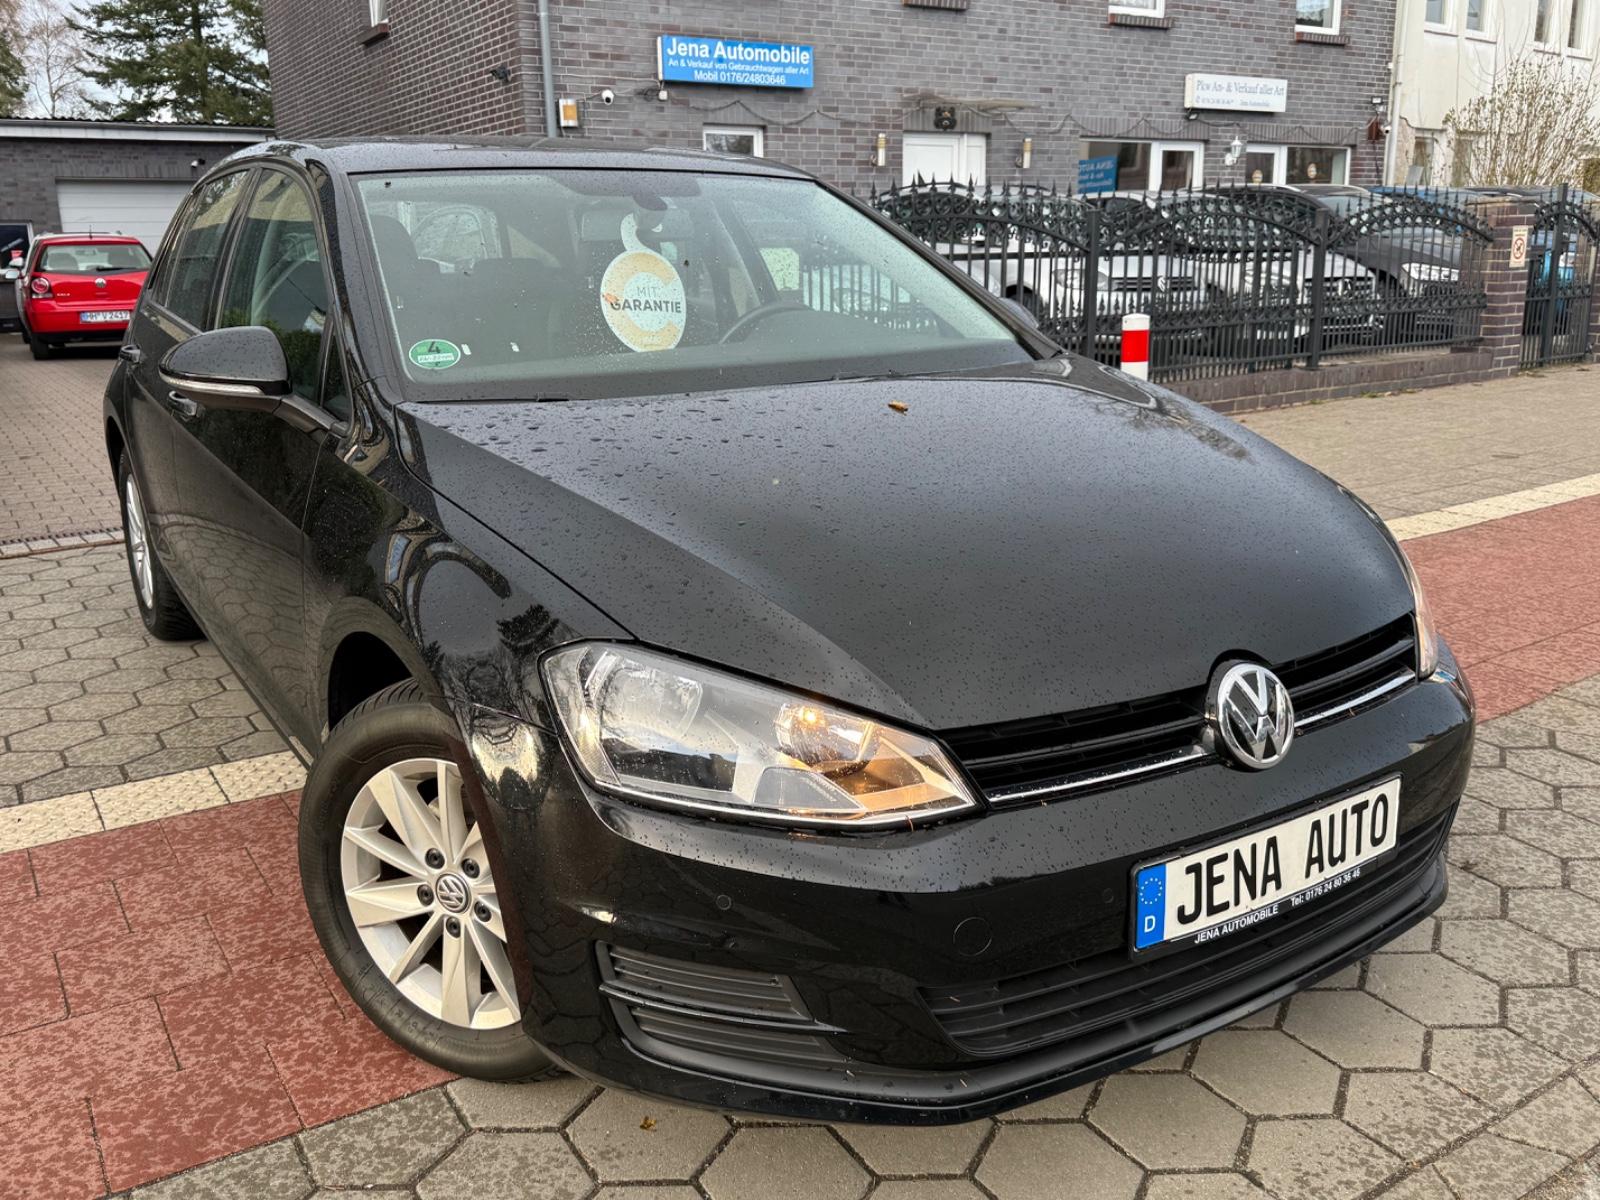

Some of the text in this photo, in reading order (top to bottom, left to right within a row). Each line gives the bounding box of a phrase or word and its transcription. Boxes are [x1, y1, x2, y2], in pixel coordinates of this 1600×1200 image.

[667, 37, 810, 64] Jena Automobile
[668, 58, 679, 67] An
[680, 59, 686, 67] &
[686, 60, 714, 69] Verkauf
[715, 62, 727, 70] von
[728, 62, 784, 75] Gebrauchtwagen
[694, 70, 718, 82] Mobil
[637, 286, 658, 298] MIT
[610, 299, 682, 314] GARANTIE
[428, 341, 442, 354] 4
[1144, 792, 1389, 933] D JENA AUTO
[1194, 928, 1220, 944] JENA
[1221, 904, 1279, 935] AUTOMOBILE
[1290, 894, 1304, 907] Tel:
[1305, 885, 1323, 901] 0176
